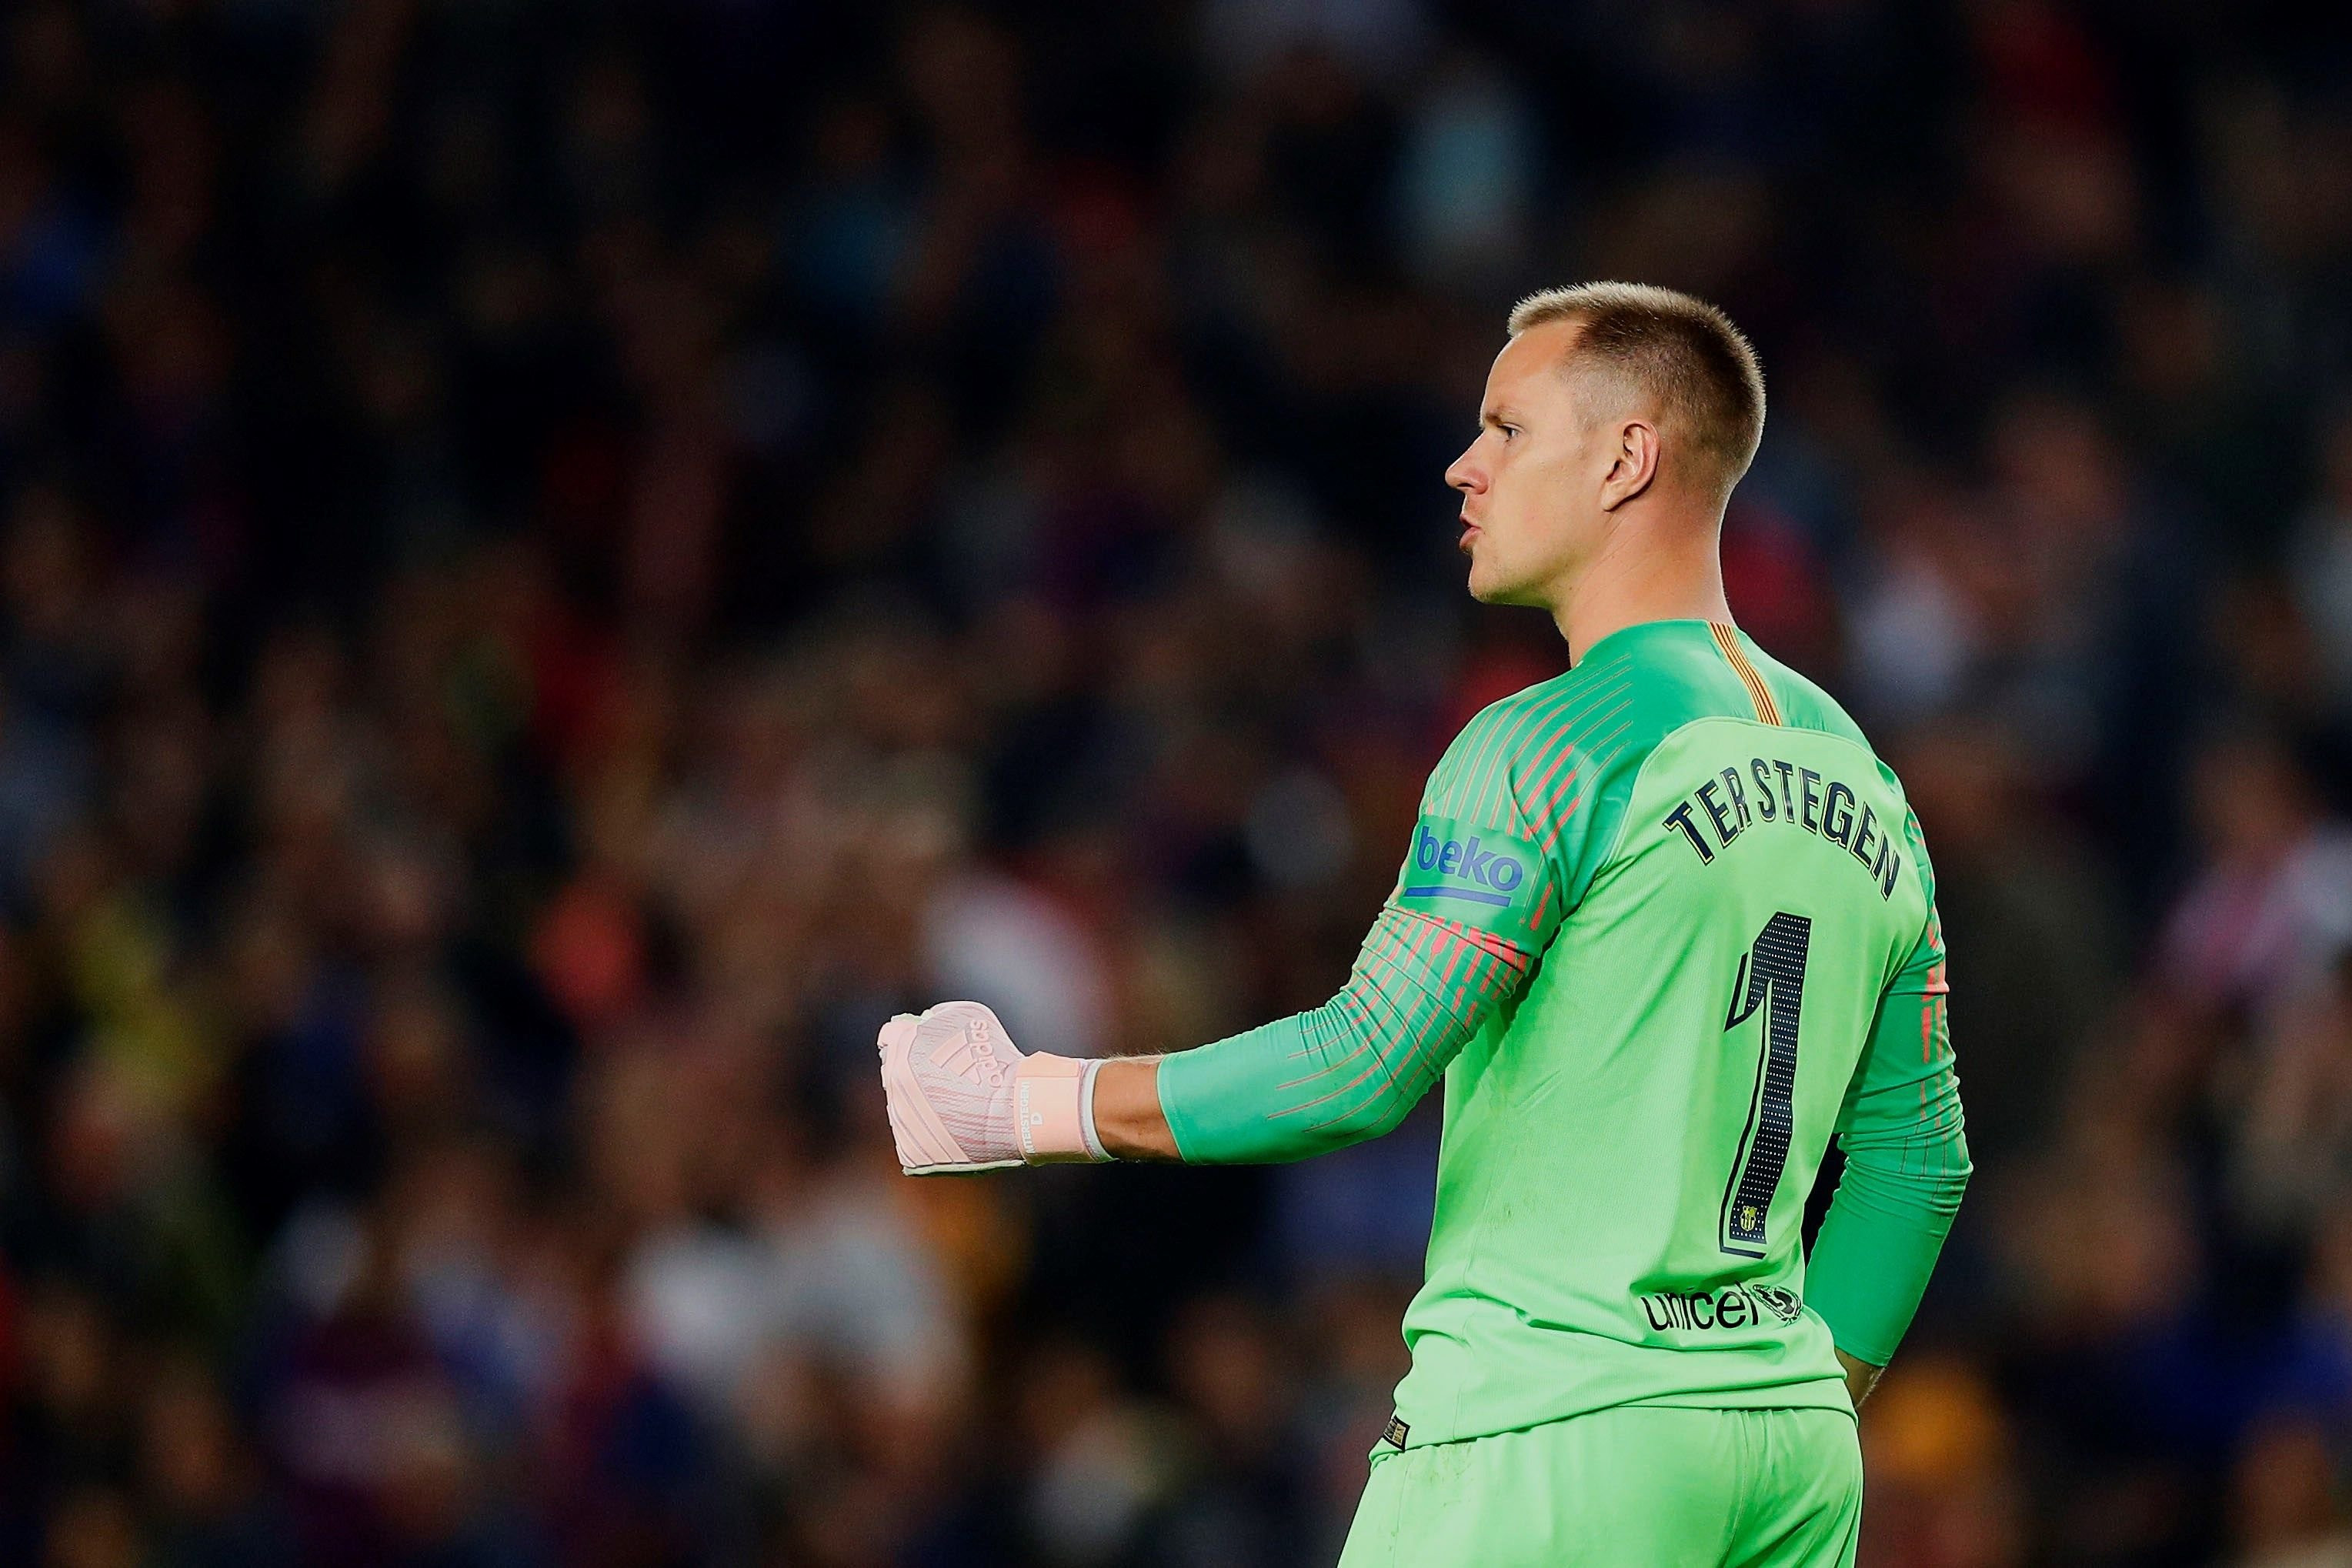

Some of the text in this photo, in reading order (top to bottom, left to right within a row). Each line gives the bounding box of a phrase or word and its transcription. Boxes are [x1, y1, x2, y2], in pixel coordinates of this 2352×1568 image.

[1416, 826, 1523, 892] beko
[1662, 758, 1900, 902] TER STEGEN
[1719, 911, 1813, 1259] 1
